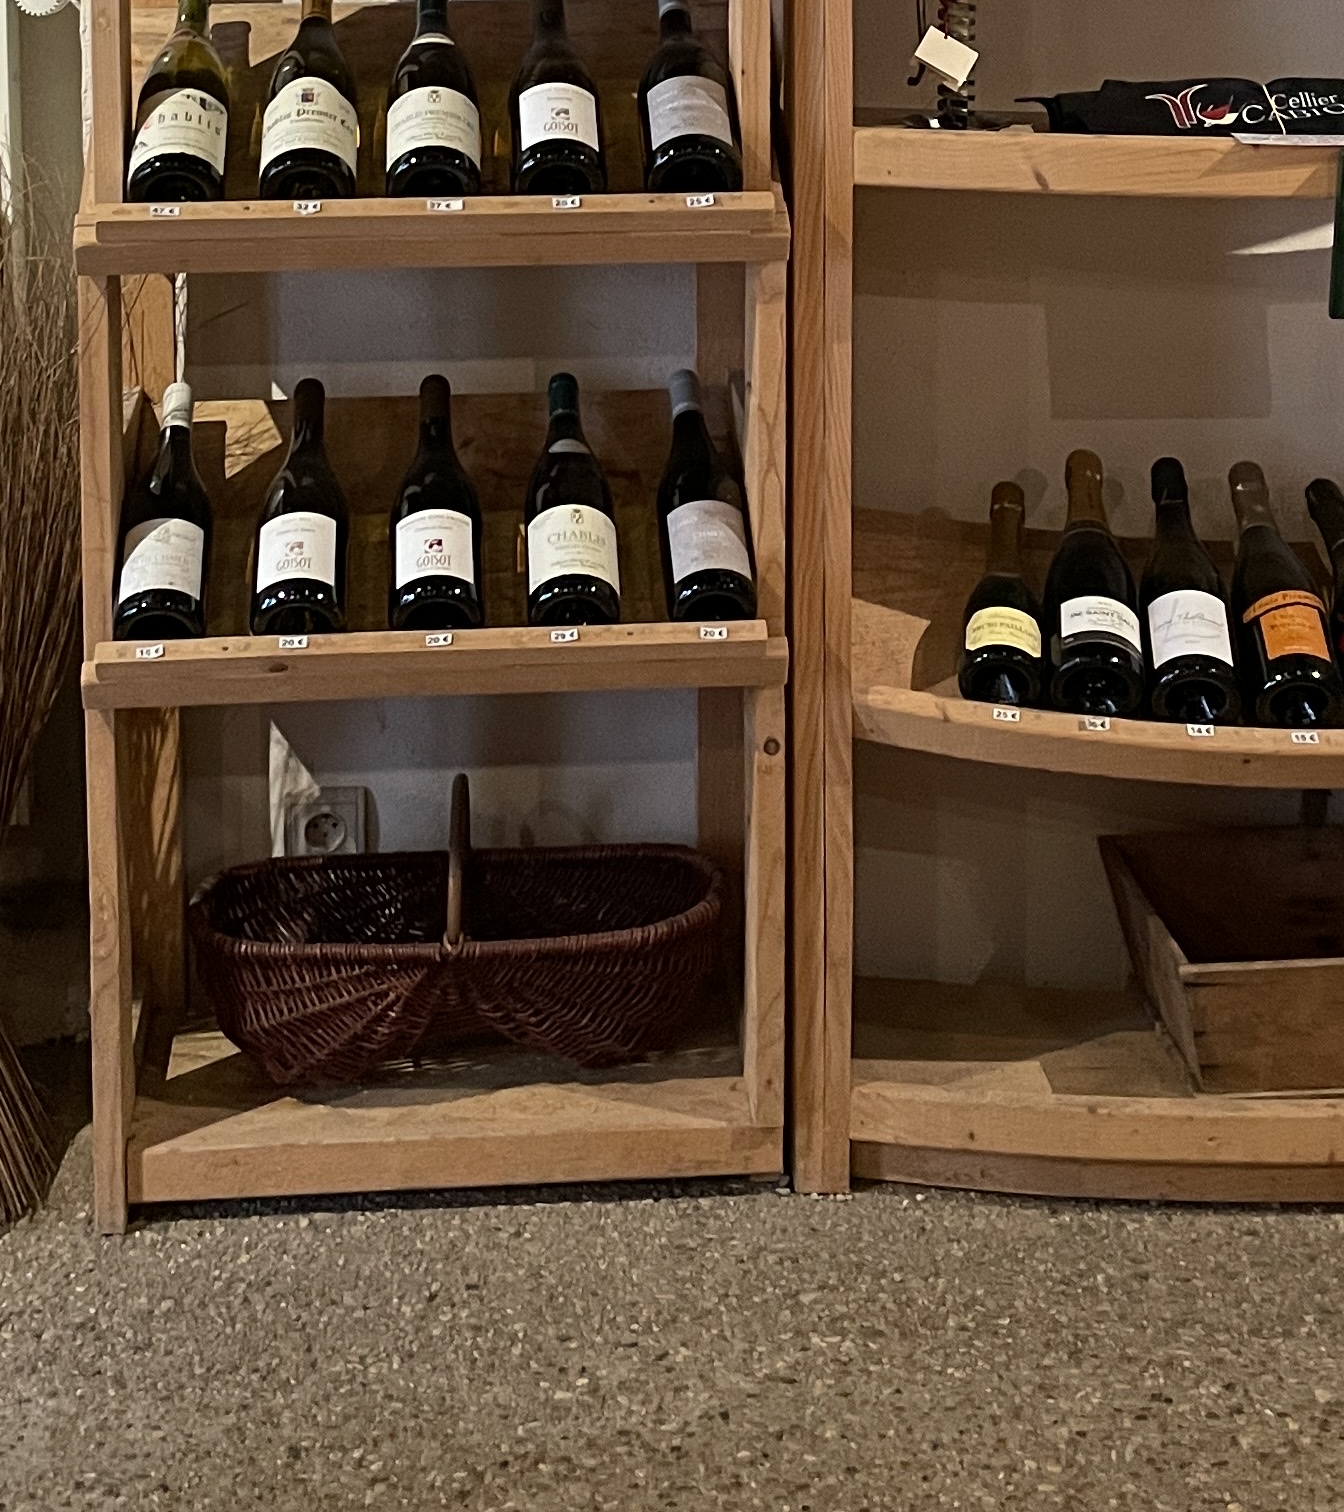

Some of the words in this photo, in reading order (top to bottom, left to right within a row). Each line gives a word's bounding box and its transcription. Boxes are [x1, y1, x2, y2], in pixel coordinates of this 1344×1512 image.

[1271, 91, 1338, 110] Cellier
[543, 123, 579, 135] GOISOT
[276, 555, 313, 572] GOISOT
[416, 554, 452, 568] GOISOT
